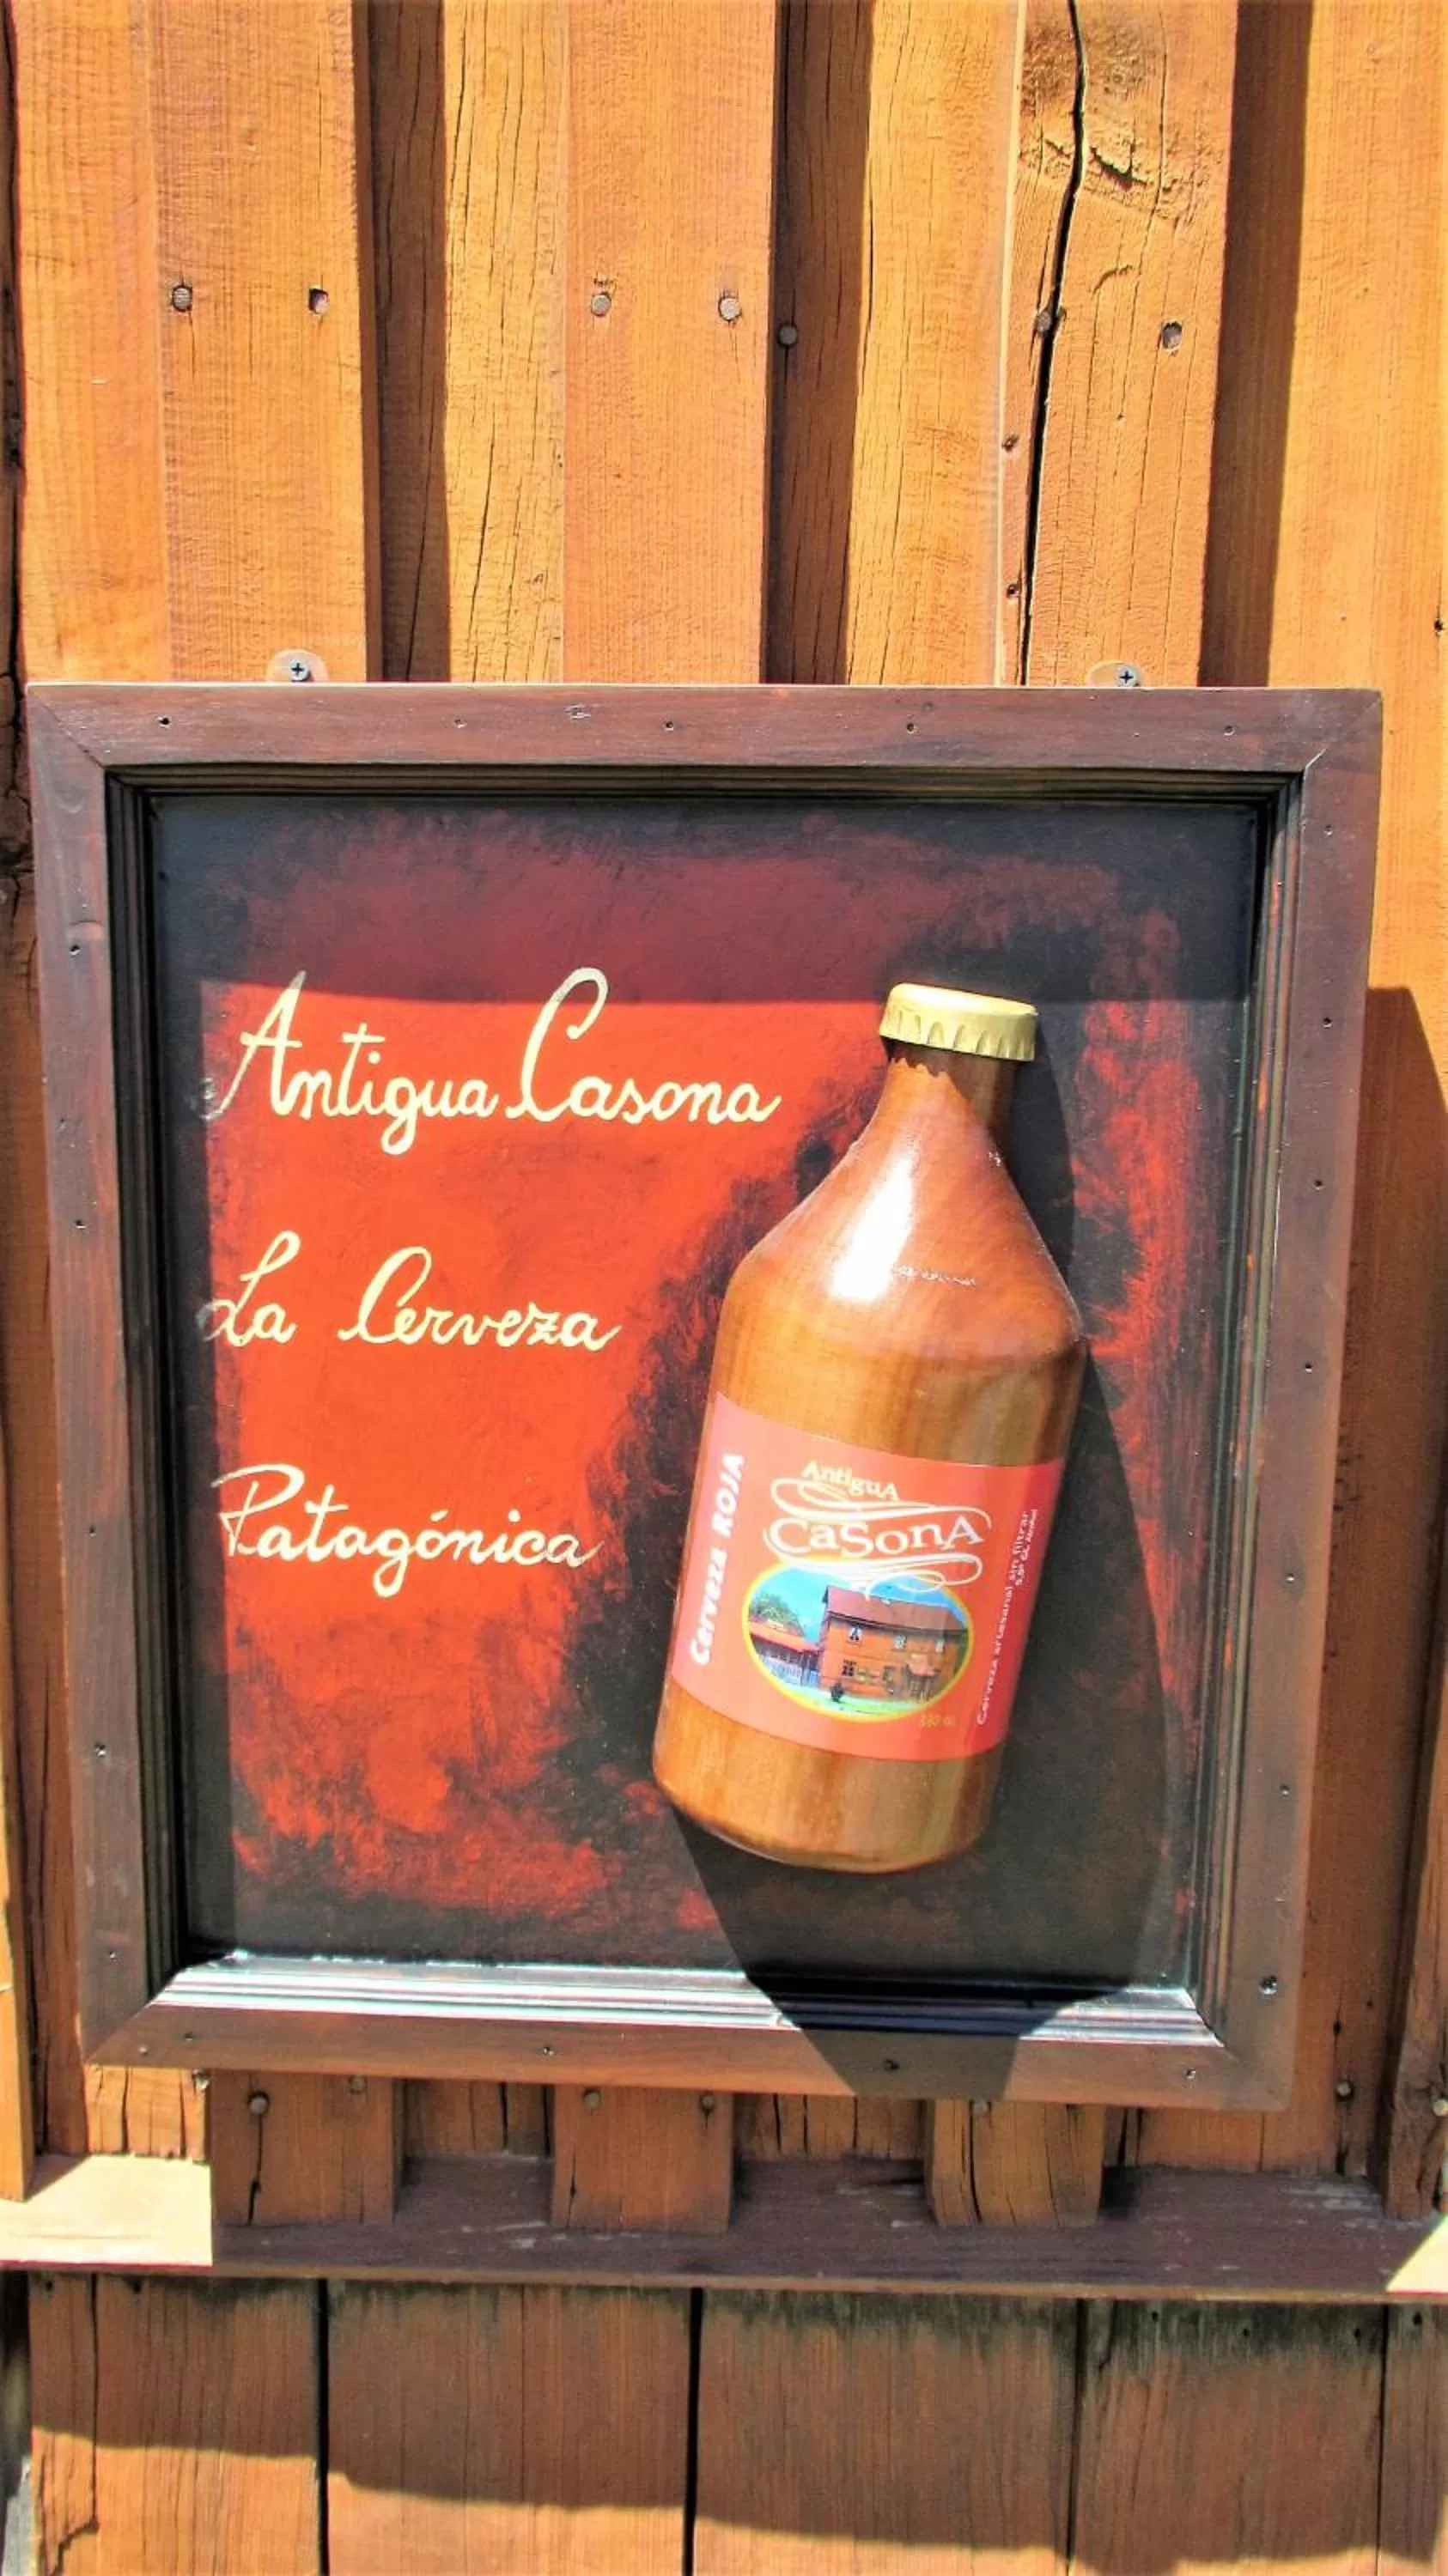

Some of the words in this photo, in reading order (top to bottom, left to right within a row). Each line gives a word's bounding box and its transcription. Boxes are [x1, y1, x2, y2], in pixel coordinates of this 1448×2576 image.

[194, 969, 499, 1156] Antigua
[505, 967, 782, 1124] Casona
[195, 1230, 301, 1347] La
[337, 1246, 622, 1352] Cerveza
[211, 1462, 605, 1598] Patagónica
[690, 1547, 728, 1666] Cerveza
[712, 1453, 744, 1539] ROJA
